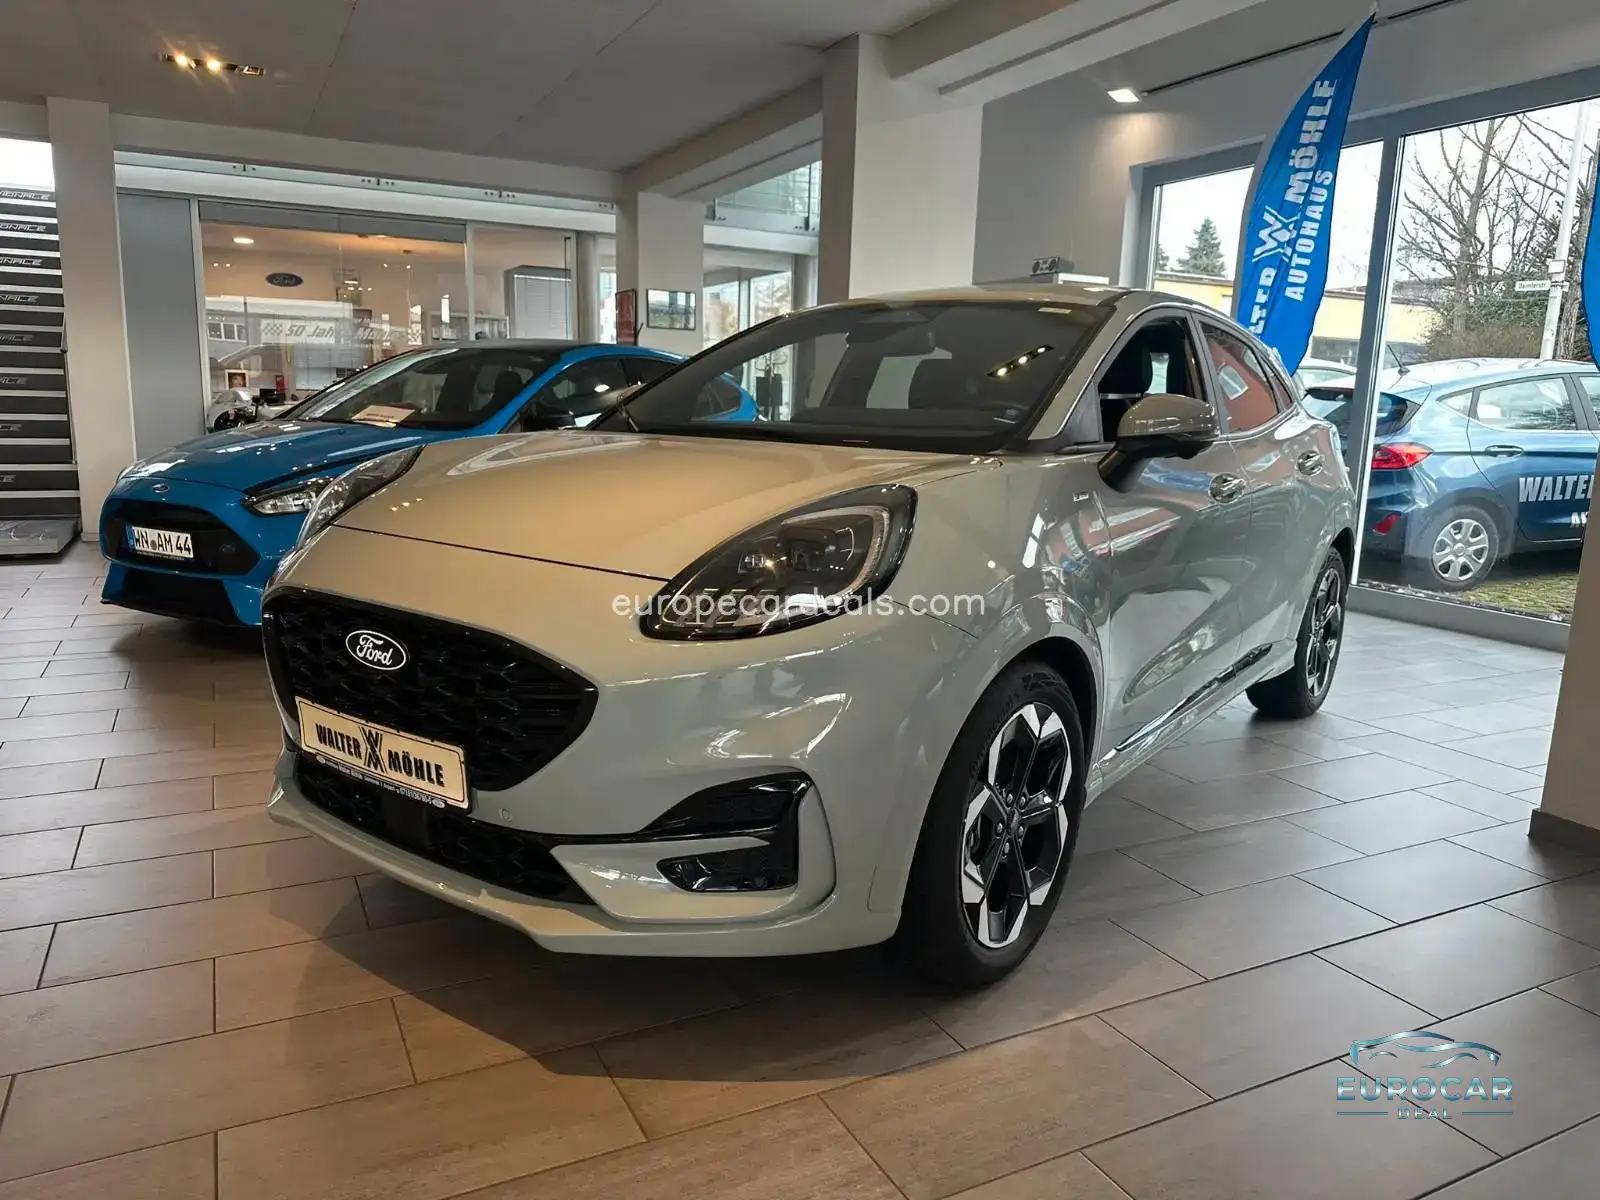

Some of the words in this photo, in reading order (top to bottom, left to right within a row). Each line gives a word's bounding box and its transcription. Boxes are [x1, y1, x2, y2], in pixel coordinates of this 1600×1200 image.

[1284, 79, 1337, 205] MÖHLE
[1284, 169, 1334, 302] AUTOHAUS
[285, 324, 306, 338] 50
[157, 532, 174, 554] AM
[175, 535, 192, 556] 44
[356, 634, 394, 666] Ford
[315, 722, 363, 761] WALTER
[387, 748, 445, 788] MÖHLE
